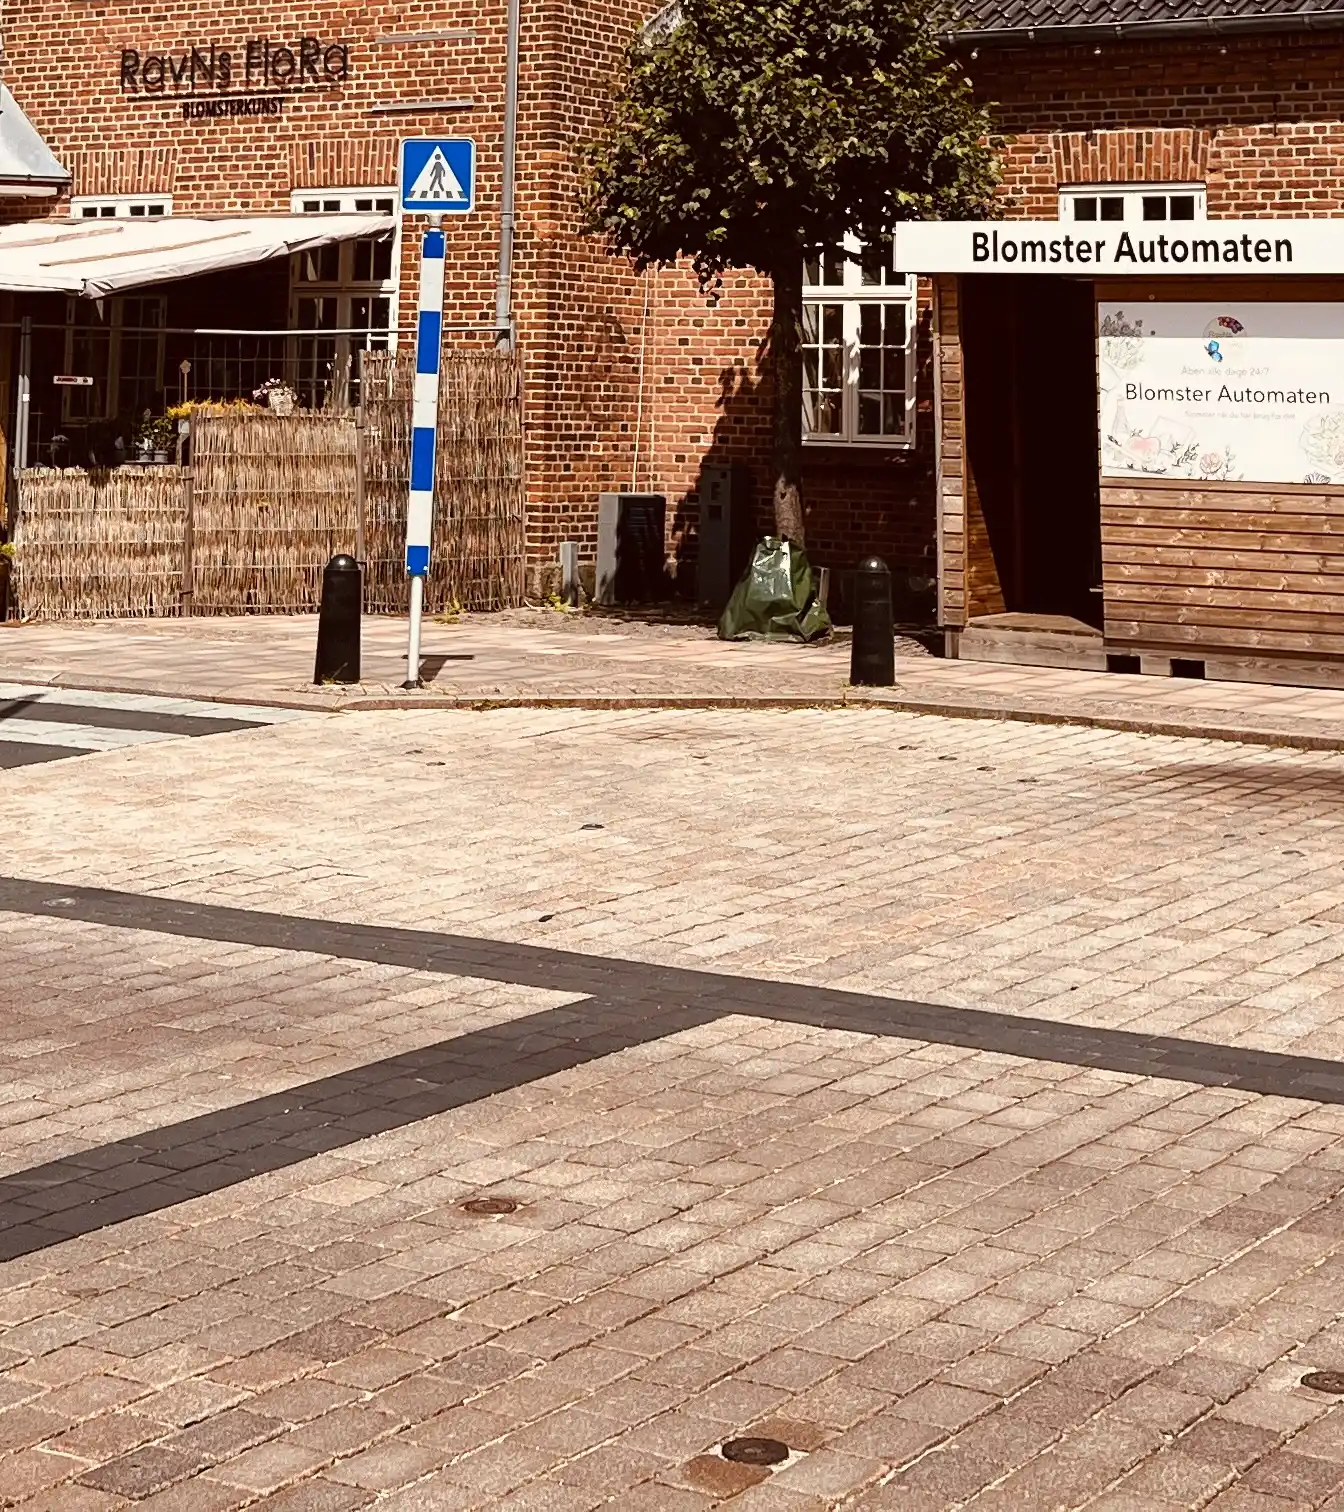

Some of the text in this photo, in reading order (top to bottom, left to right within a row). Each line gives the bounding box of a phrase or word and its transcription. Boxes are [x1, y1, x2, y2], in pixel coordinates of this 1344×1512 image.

[181, 96, 285, 118] BLOMSTERKUNST
[972, 230, 1293, 263] Blomster Automaten
[1125, 382, 1330, 404] Blomster Automaten
